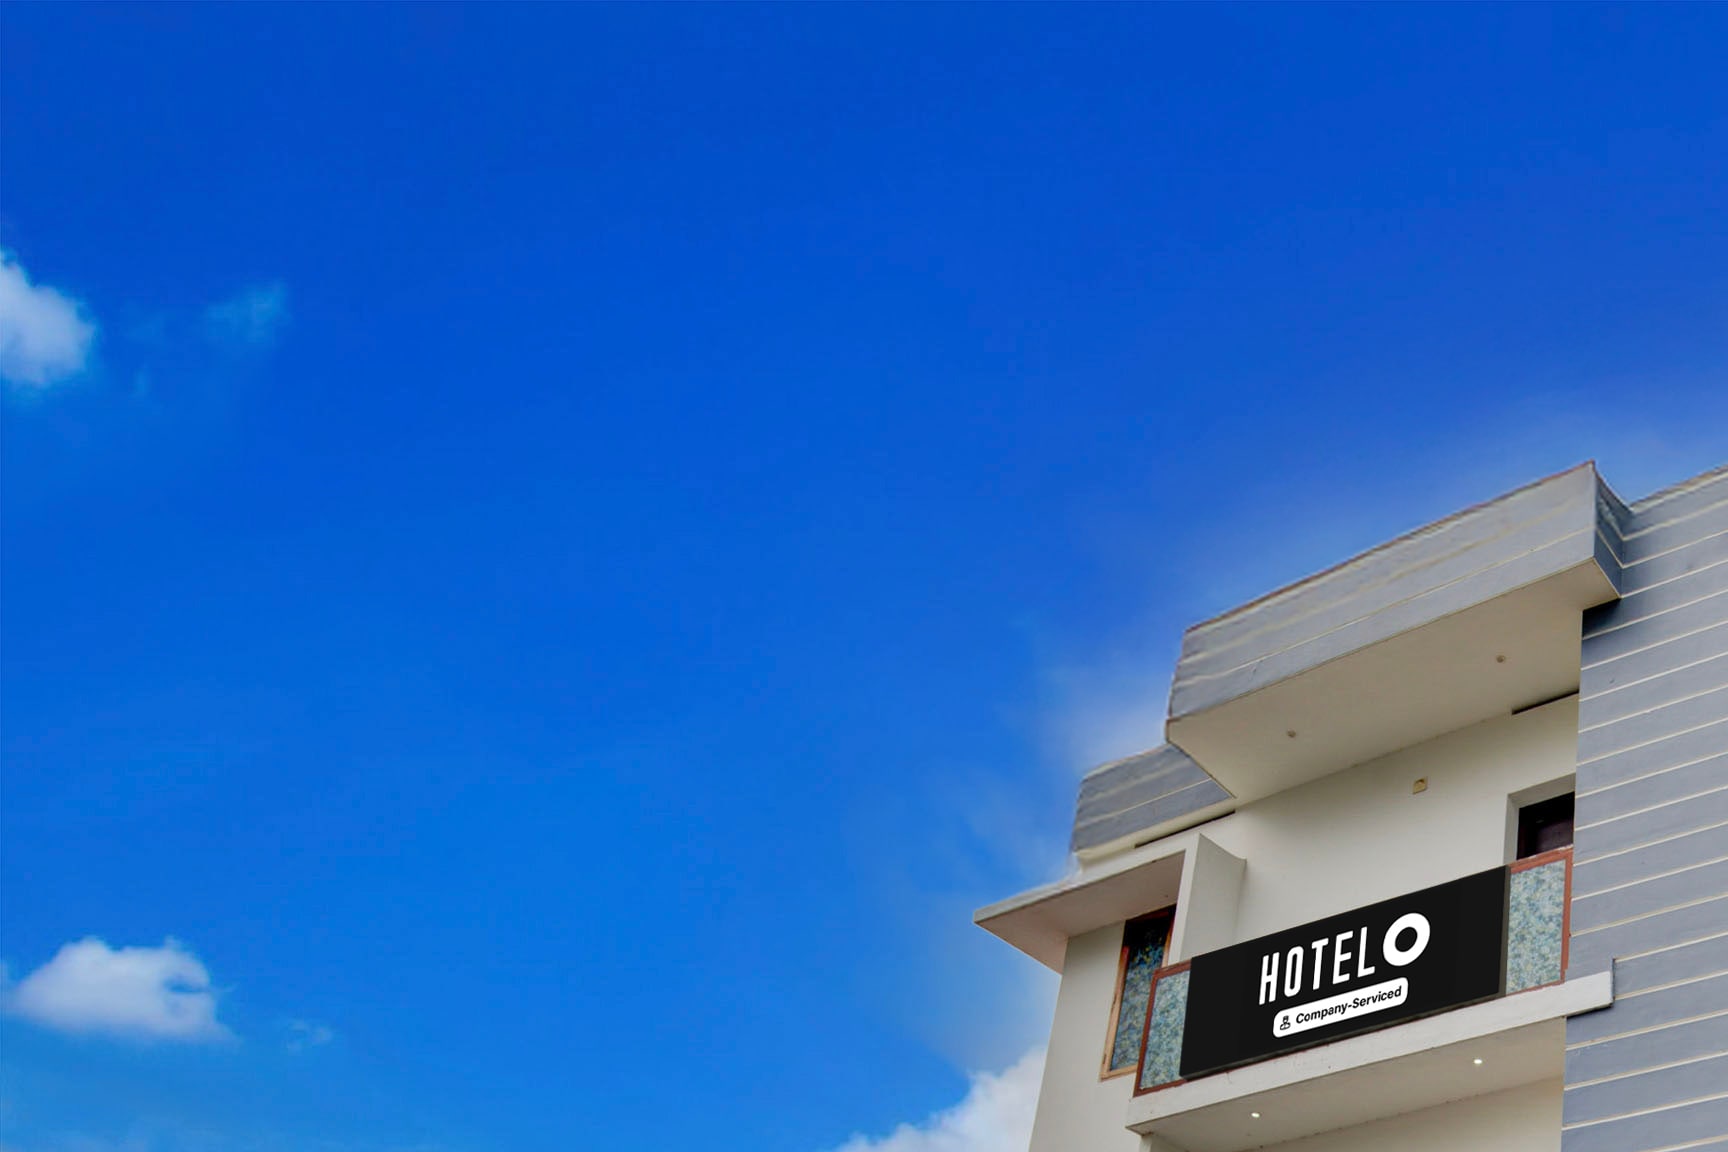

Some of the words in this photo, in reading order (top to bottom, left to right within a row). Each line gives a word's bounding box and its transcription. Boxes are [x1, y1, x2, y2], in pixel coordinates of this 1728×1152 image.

[1259, 926, 1376, 1005] HOTEL
[1383, 912, 1431, 967] O
[1295, 985, 1402, 1024] Company-Serviced
